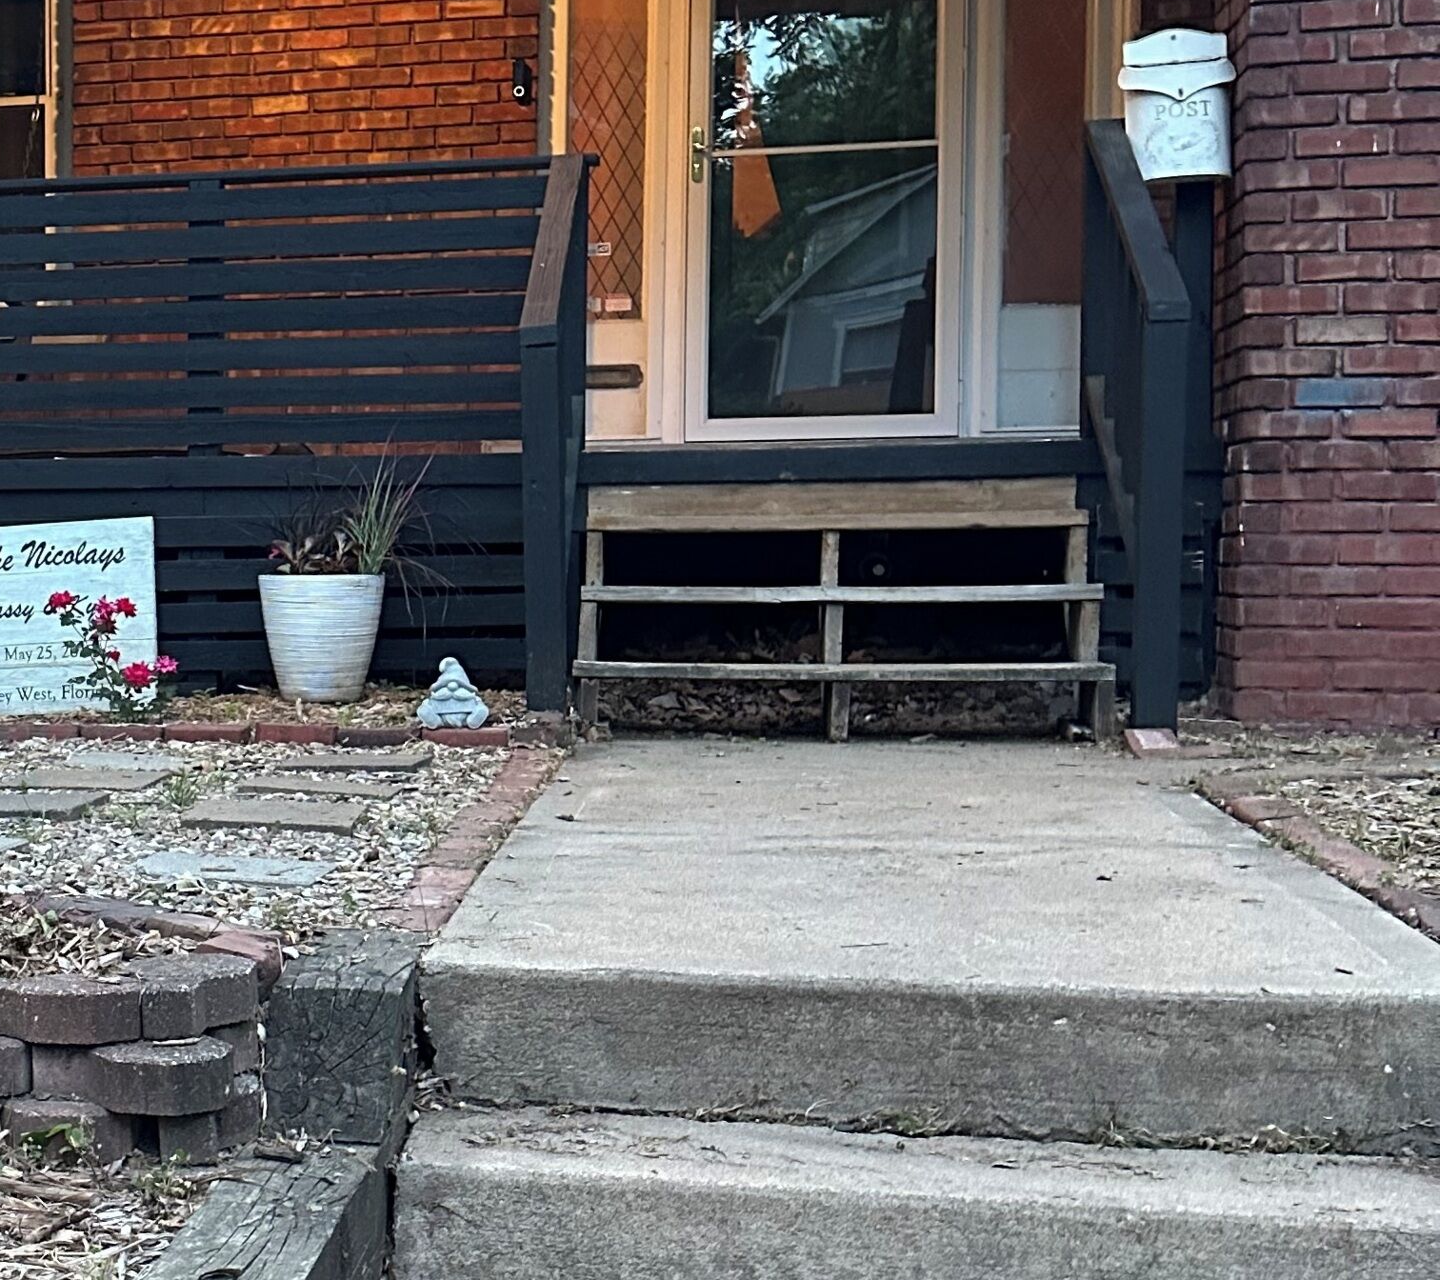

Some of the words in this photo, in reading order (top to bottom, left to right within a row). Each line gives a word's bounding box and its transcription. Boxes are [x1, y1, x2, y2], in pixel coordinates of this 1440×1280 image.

[1154, 100, 1212, 121] POST
[20, 540, 126, 572] Nicolays
[4, 646, 33, 664] May
[36, 645, 57, 661] 25,
[16, 685, 57, 702] West,
